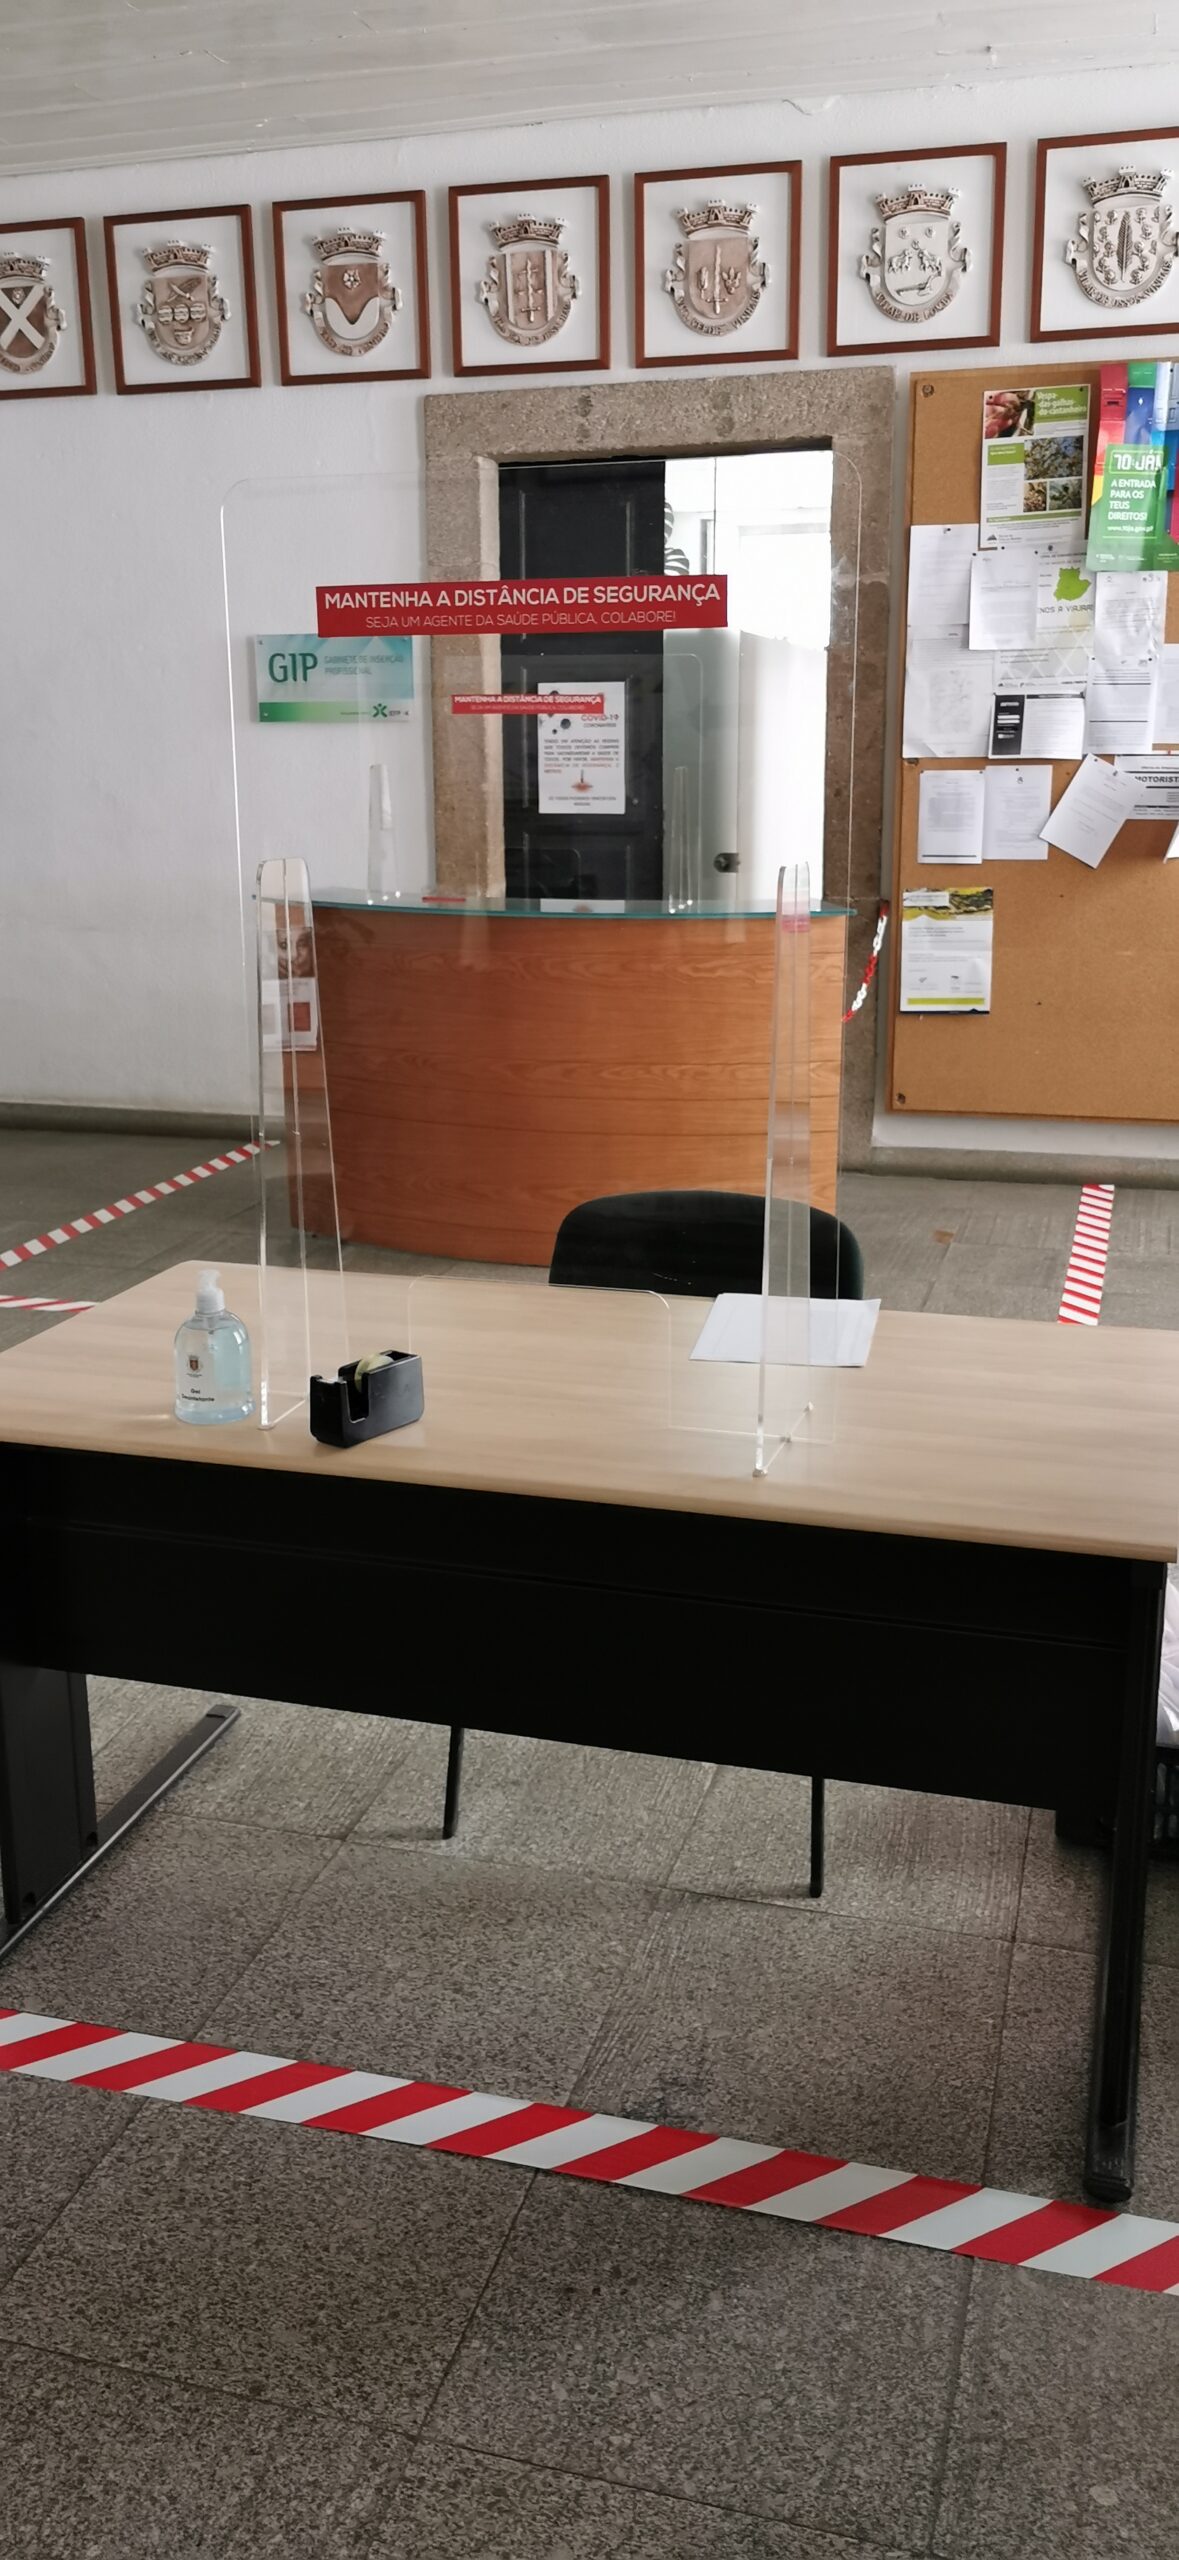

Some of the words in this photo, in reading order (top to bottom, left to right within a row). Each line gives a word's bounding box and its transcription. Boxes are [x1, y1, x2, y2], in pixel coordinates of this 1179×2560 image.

[1111, 479, 1118, 488] A
[1118, 479, 1156, 488] ENTRADA
[1109, 490, 1131, 499] PARA
[1132, 490, 1145, 499] OS
[1109, 501, 1130, 509] TEUS
[1107, 511, 1148, 521] DIREITOS!
[325, 591, 433, 609] MANTENHA
[436, 590, 451, 607] A
[454, 585, 559, 606] DISTÂNCIA
[563, 587, 589, 604] DE
[593, 583, 720, 606] SEGURANÇA
[366, 616, 399, 628] SEJA
[401, 616, 421, 628] UM
[424, 615, 473, 627] AGENTE
[475, 614, 493, 626] DA
[497, 611, 539, 626] SAÚDE
[542, 610, 597, 625] PÚBLICA,
[601, 610, 676, 624] COLABORE!
[268, 652, 318, 683] GIP
